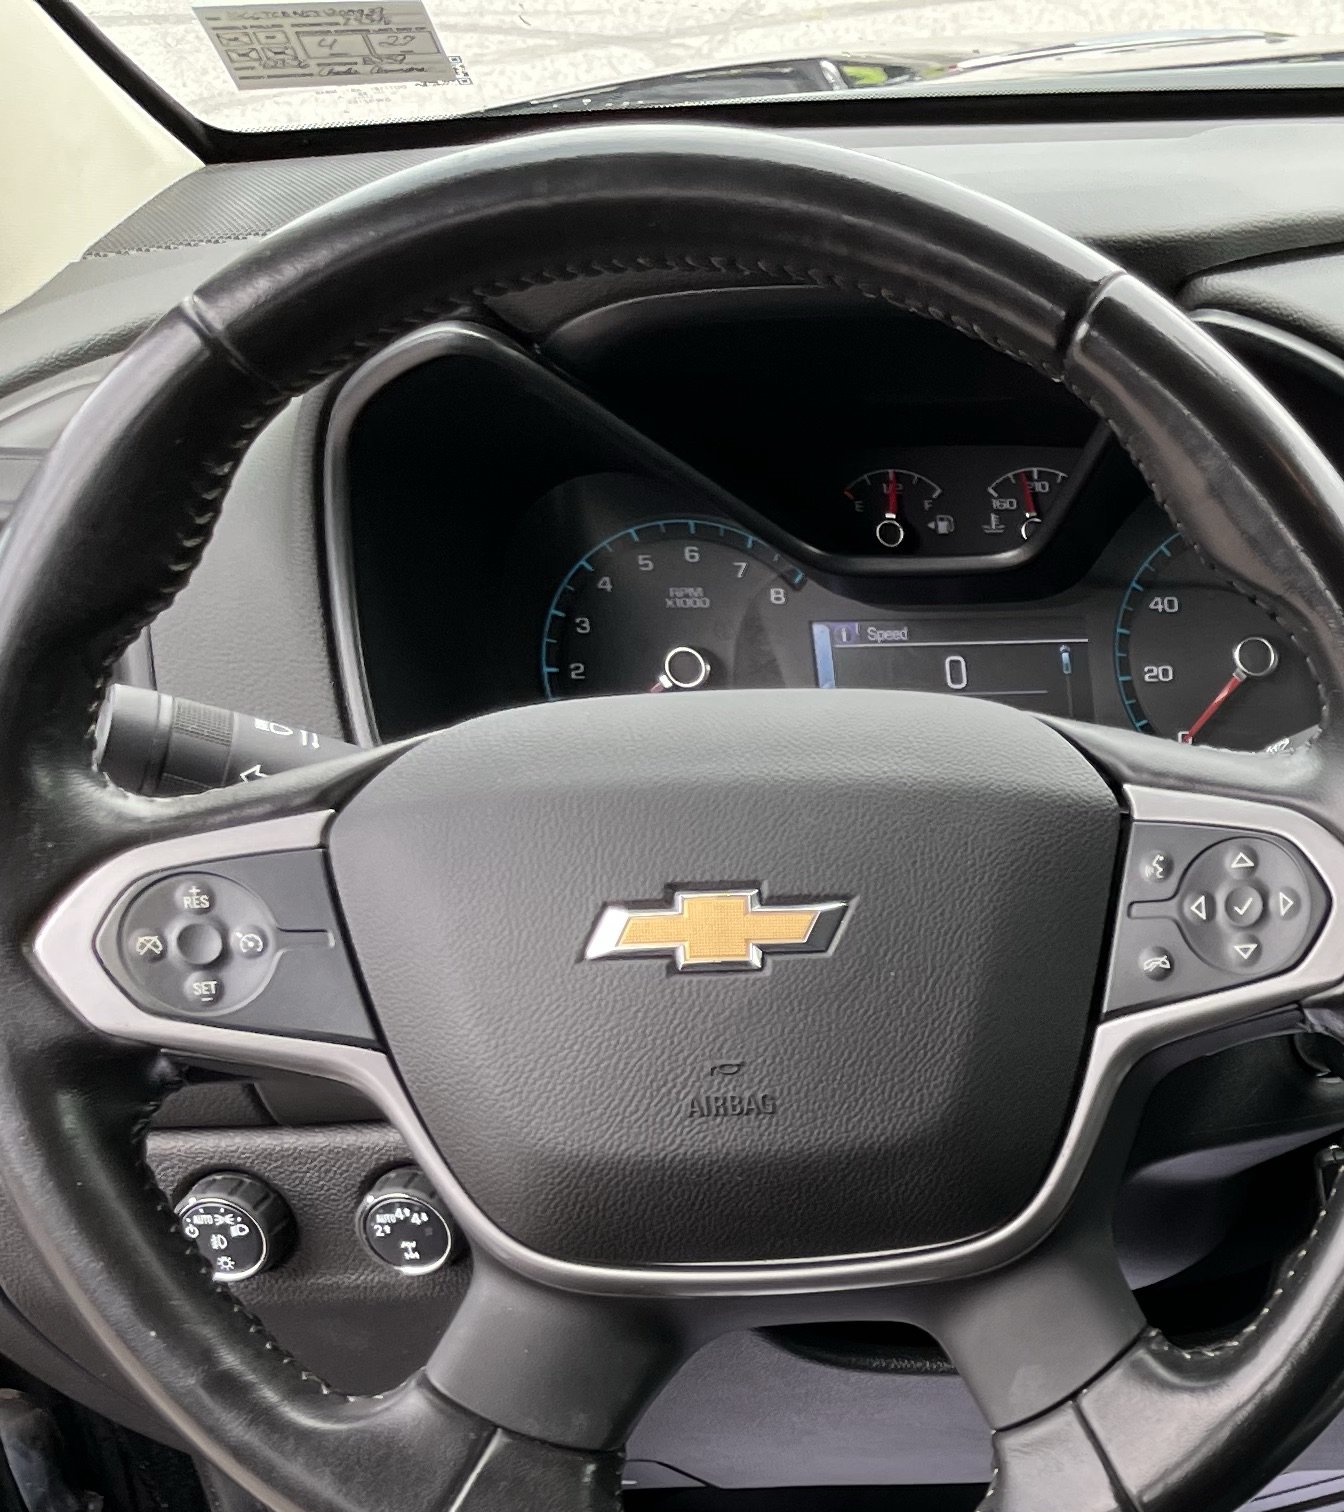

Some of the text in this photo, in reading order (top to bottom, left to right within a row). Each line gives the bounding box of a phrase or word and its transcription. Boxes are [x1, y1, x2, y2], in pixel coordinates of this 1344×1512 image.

[992, 499, 1017, 510] 160
[638, 554, 654, 571] 5
[684, 546, 700, 562] 6
[733, 562, 748, 578] 7
[597, 576, 612, 593] 4
[668, 587, 705, 598] RPM
[769, 588, 786, 604] 8
[1148, 596, 1180, 613] 40
[575, 617, 592, 634] 3
[866, 626, 909, 643] Speed
[569, 663, 586, 681] 2
[944, 655, 967, 690] 0
[1143, 664, 1174, 682] 20
[183, 894, 211, 909] RES
[192, 980, 219, 996] SET
[687, 1093, 778, 1119] AIRBAG
